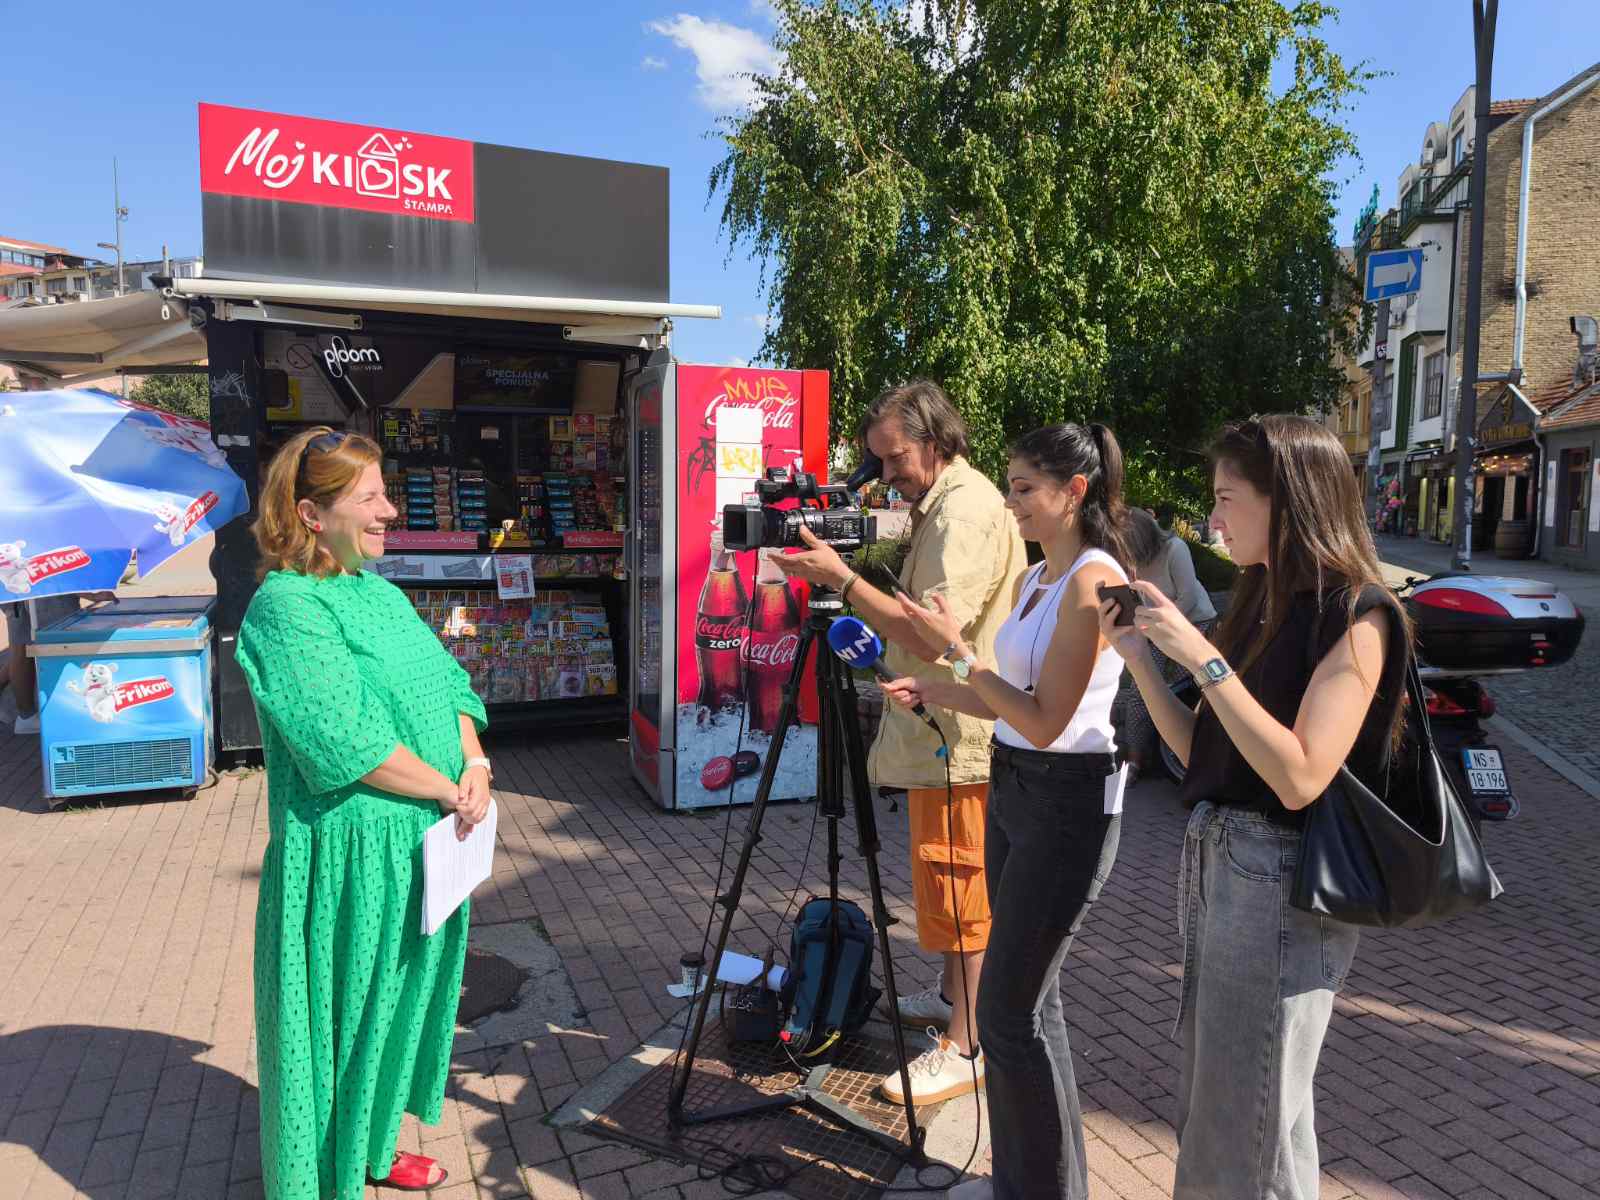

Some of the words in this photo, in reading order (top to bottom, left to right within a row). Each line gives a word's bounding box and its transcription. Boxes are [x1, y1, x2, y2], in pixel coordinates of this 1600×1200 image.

[224, 127, 306, 188] Moj
[486, 368, 549, 380] SPECIJALNA
[709, 637, 741, 650] zero
[1473, 752, 1487, 768] NS
